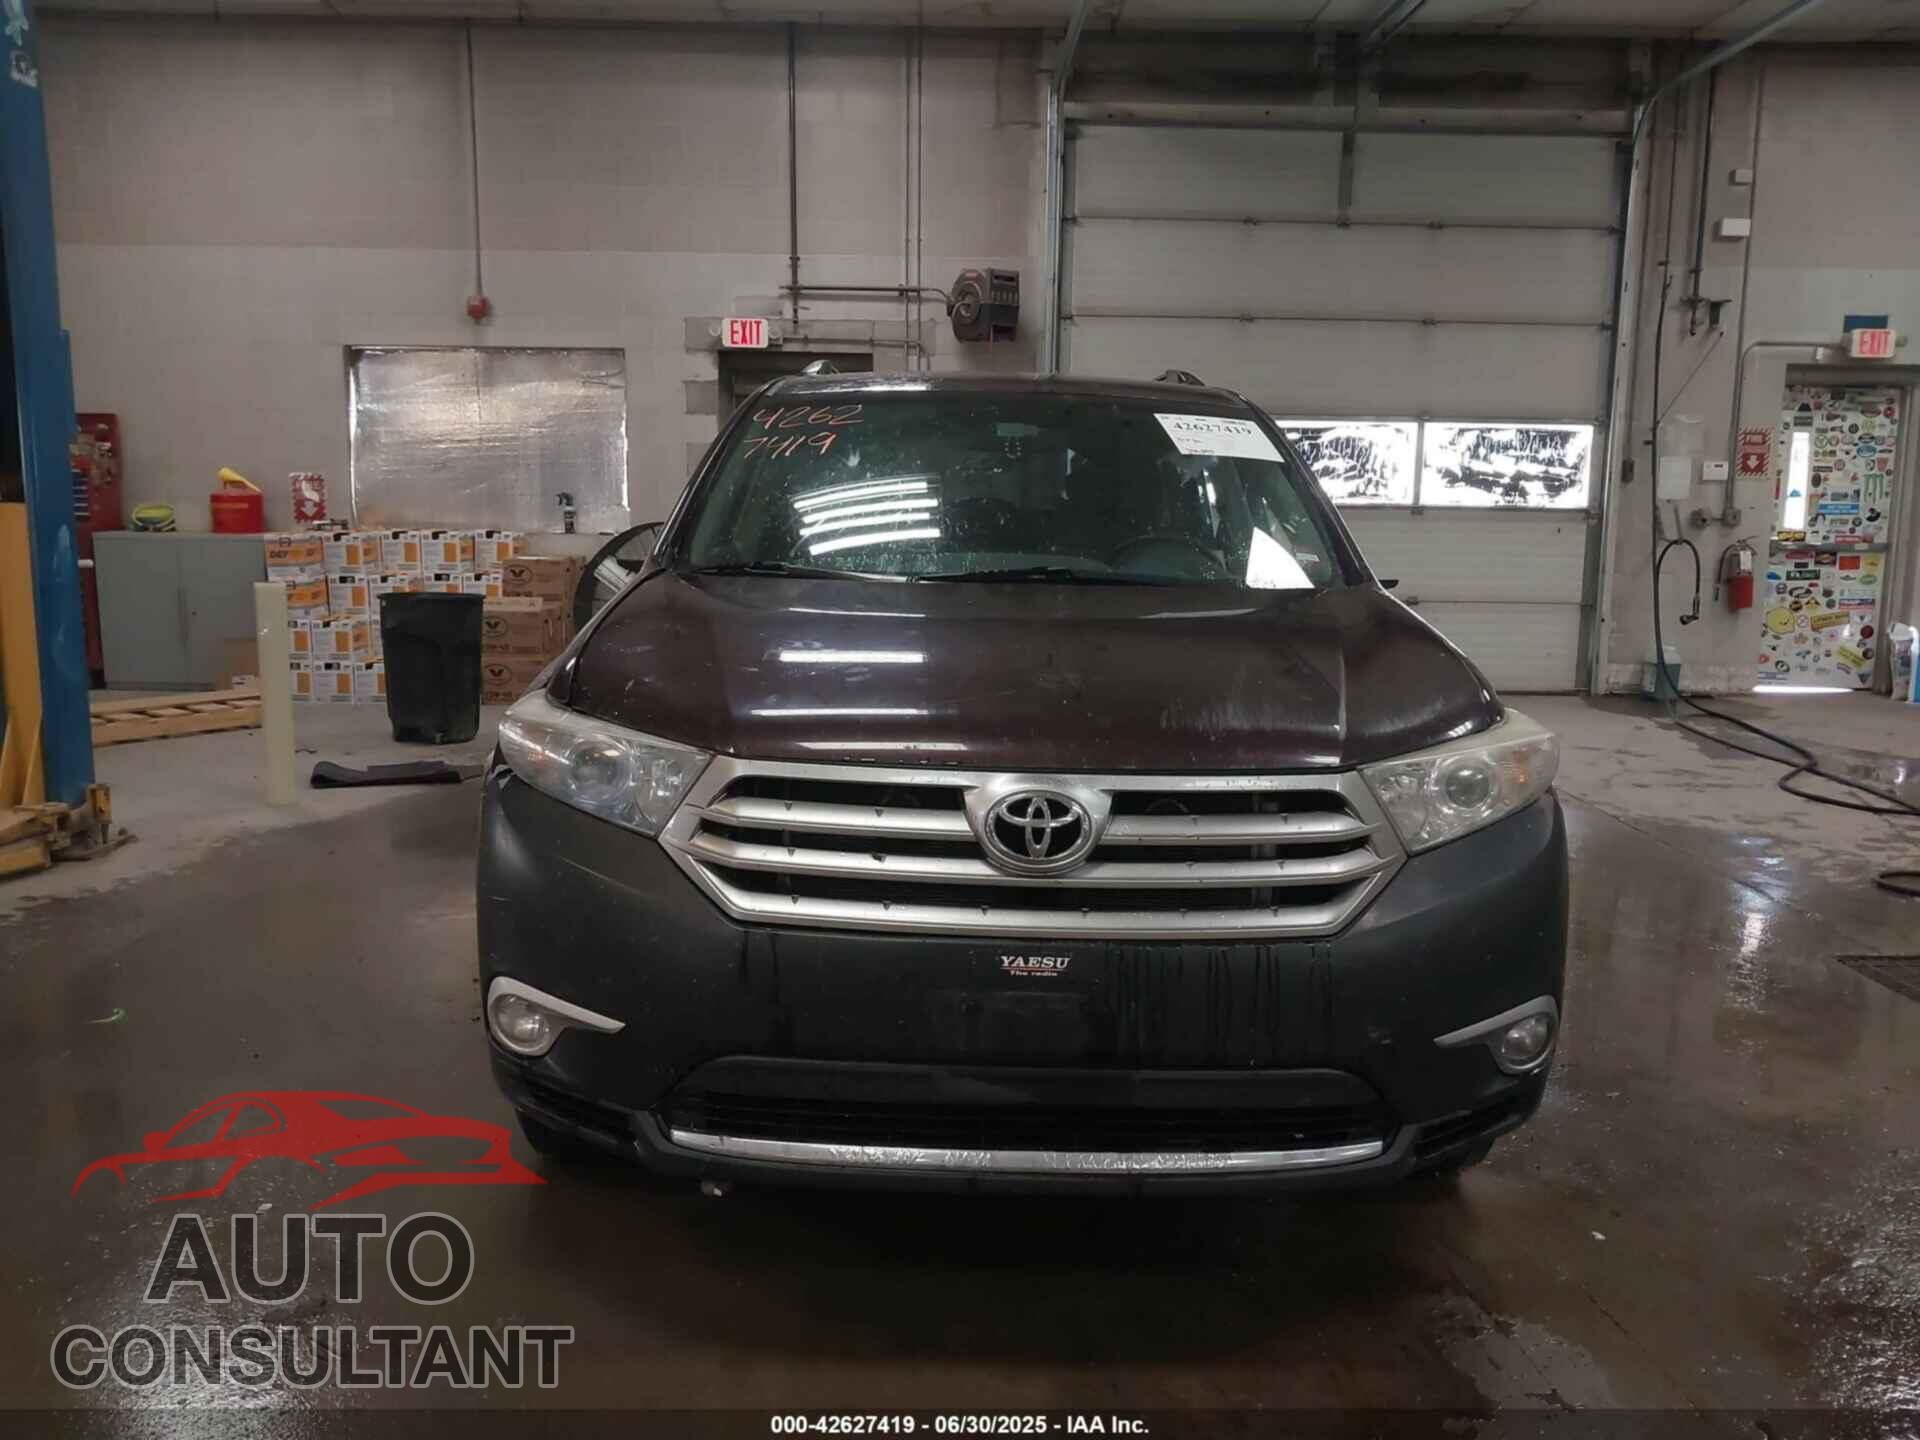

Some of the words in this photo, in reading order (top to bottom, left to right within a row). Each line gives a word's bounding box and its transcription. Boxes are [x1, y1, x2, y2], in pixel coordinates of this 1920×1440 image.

[730, 319, 762, 345] EXIT
[1859, 331, 1889, 354] EXIT
[753, 404, 864, 429] 4262
[1174, 421, 1252, 434] 42627419
[743, 431, 838, 459] 7419
[1000, 956, 1071, 969] YAESU
